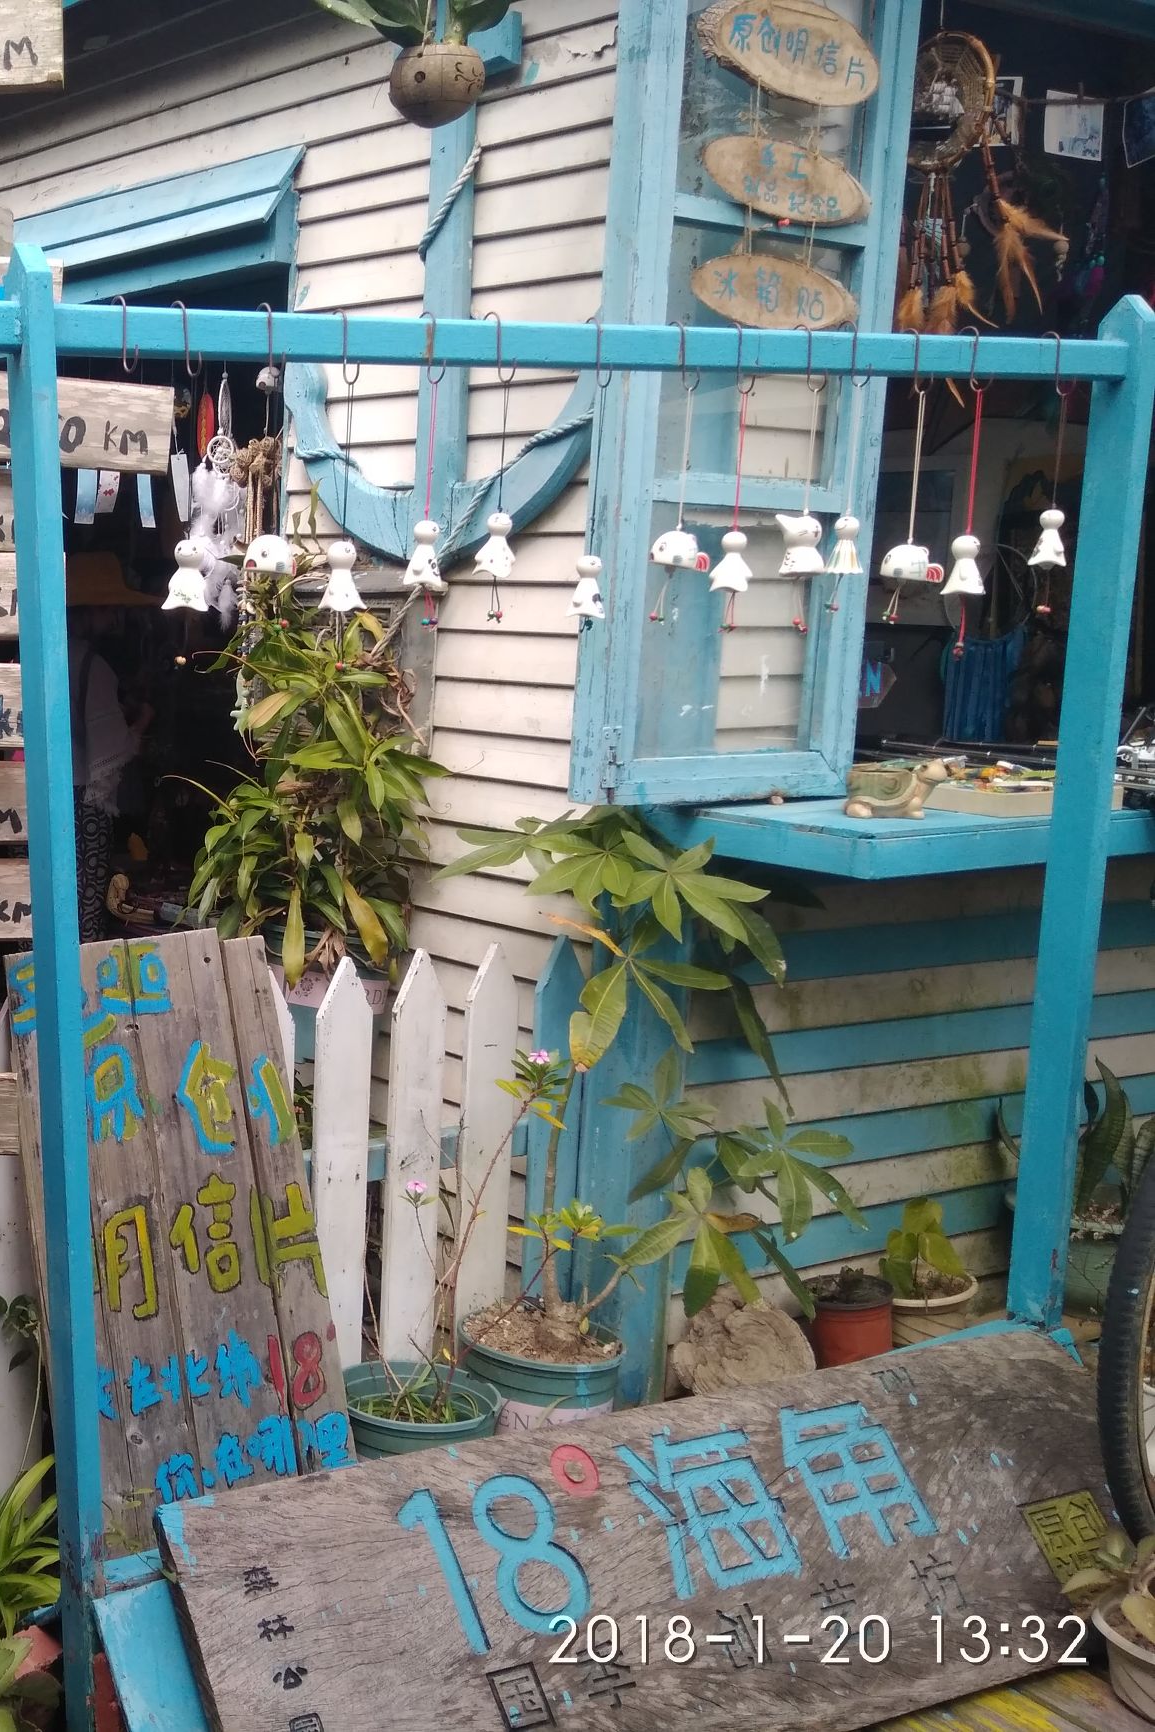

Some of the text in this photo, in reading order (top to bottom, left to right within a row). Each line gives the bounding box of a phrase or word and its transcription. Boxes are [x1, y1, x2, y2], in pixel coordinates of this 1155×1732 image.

[729, 13, 866, 91] 原创明信片
[712, 266, 825, 322] 冰箱贴
